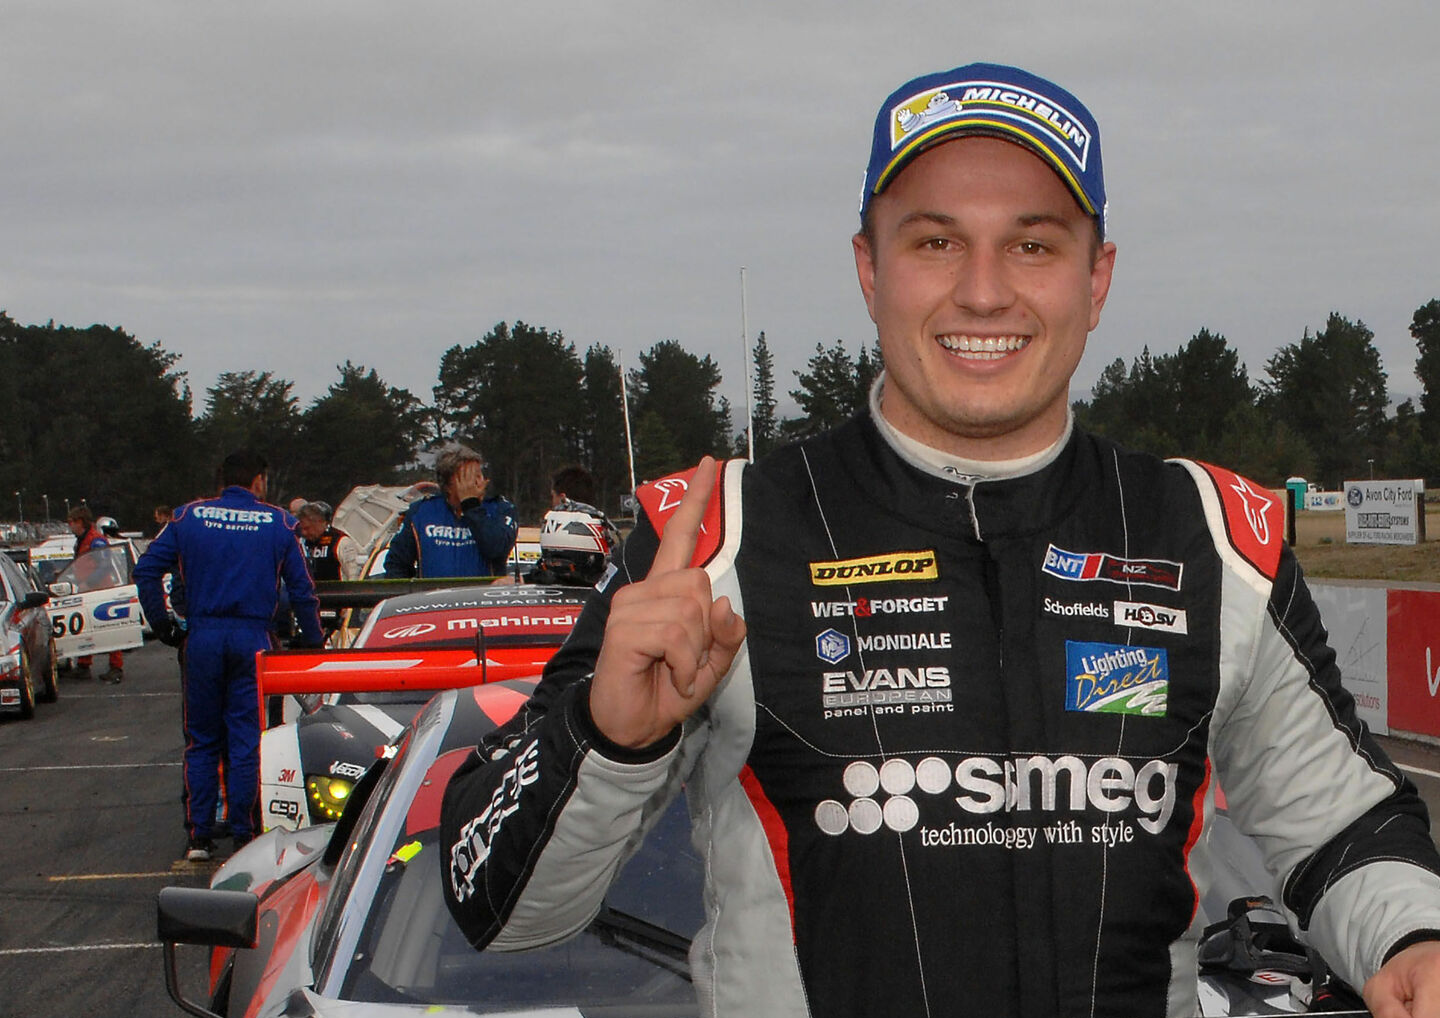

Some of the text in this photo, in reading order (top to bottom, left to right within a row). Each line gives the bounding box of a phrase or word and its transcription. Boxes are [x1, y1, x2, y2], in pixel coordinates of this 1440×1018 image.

[962, 88, 1086, 148] MICHELIN
[1366, 487, 1413, 504] Avon City Ford
[205, 520, 259, 532] tyre service
[814, 558, 934, 579] DUNLOP
[1046, 551, 1146, 574] BNT NZ
[811, 596, 949, 618] WET&FORGET
[1044, 598, 1109, 618] Schofields
[52, 612, 84, 638] 50
[448, 615, 577, 630] Mahind
[858, 633, 952, 652] MONDIALE
[1082, 649, 1148, 677] Lighting
[823, 667, 951, 692] EVANS
[1075, 654, 1162, 709] Direct
[825, 689, 951, 705] EUROPEAN
[824, 702, 954, 719] panel and paint
[278, 768, 296, 783] 3M
[955, 756, 1179, 835] smeg
[1043, 820, 1083, 844] with
[1091, 820, 1134, 848] style
